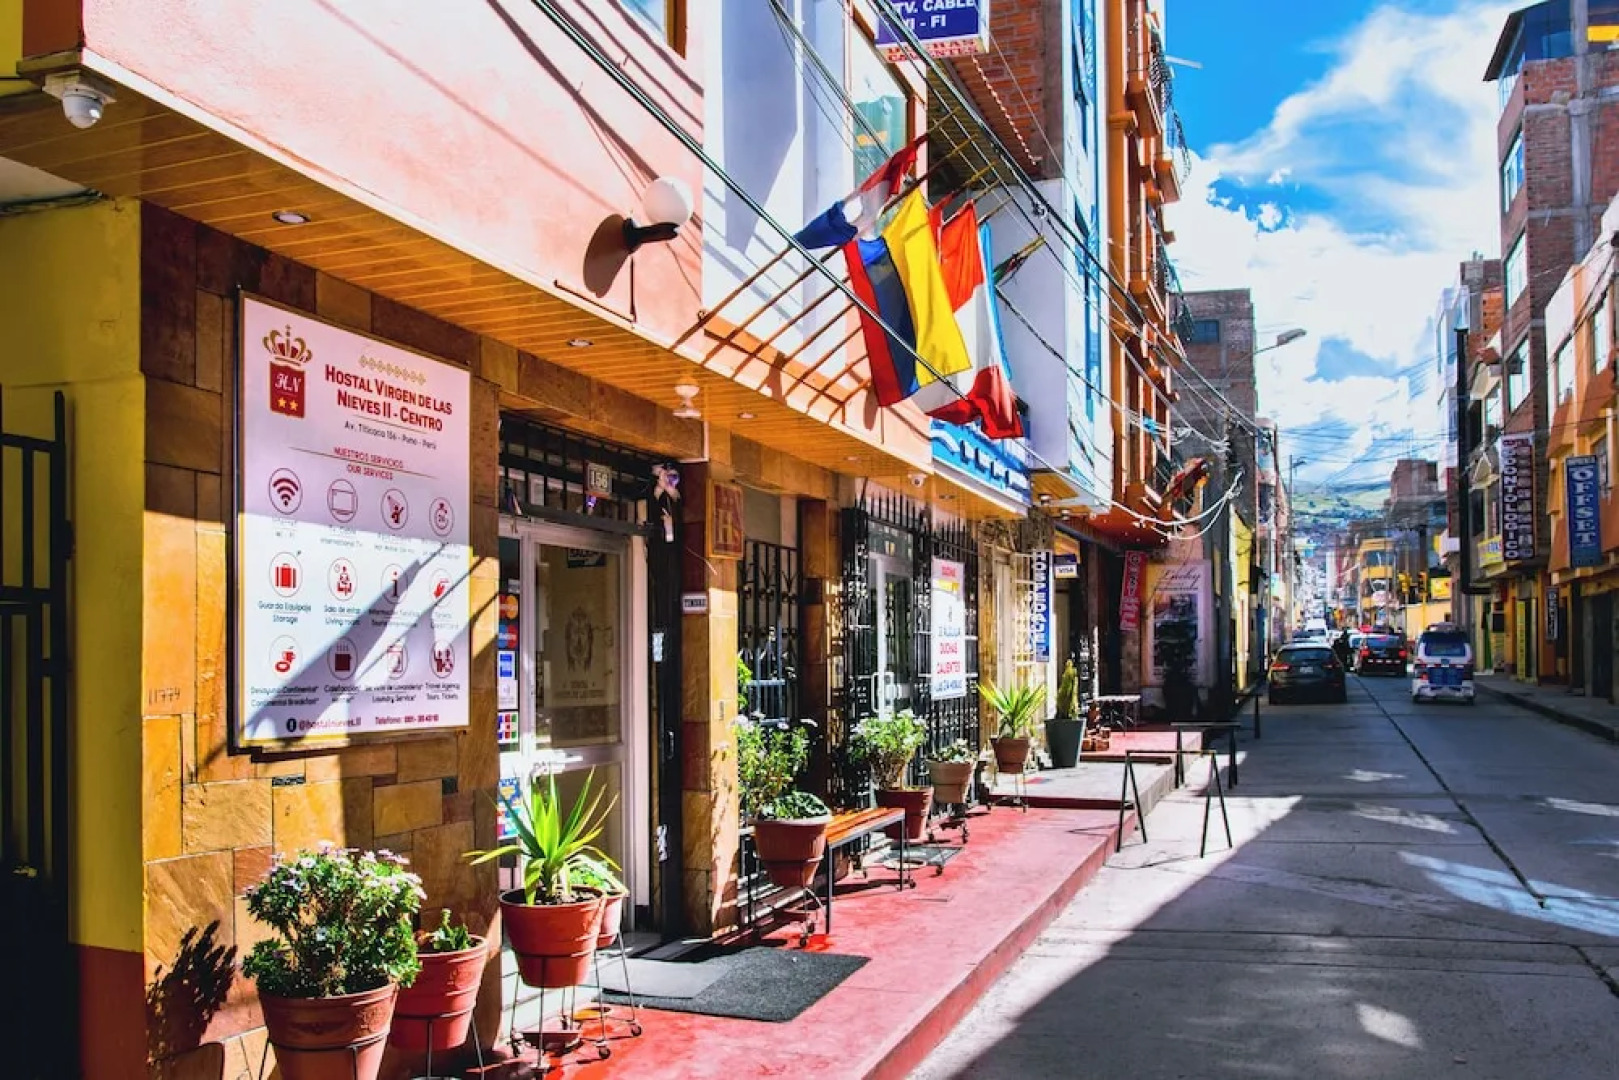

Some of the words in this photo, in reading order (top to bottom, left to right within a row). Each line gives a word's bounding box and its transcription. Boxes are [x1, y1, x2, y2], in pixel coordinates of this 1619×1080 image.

[922, 0, 975, 12] CABLE
[930, 14, 946, 28] FI
[325, 364, 373, 393] HOSTAL
[374, 378, 416, 406] VIRGEN
[418, 394, 432, 410] DE
[433, 399, 452, 416] LAS
[337, 389, 380, 416] NIEVES
[383, 401, 391, 418] II
[400, 406, 443, 432] CENTRO
[344, 420, 356, 432] Av.
[346, 463, 362, 475] OUR
[364, 466, 394, 480] SERVICES
[1572, 466, 1596, 543] OFFSET
[273, 615, 298, 625] Storage
